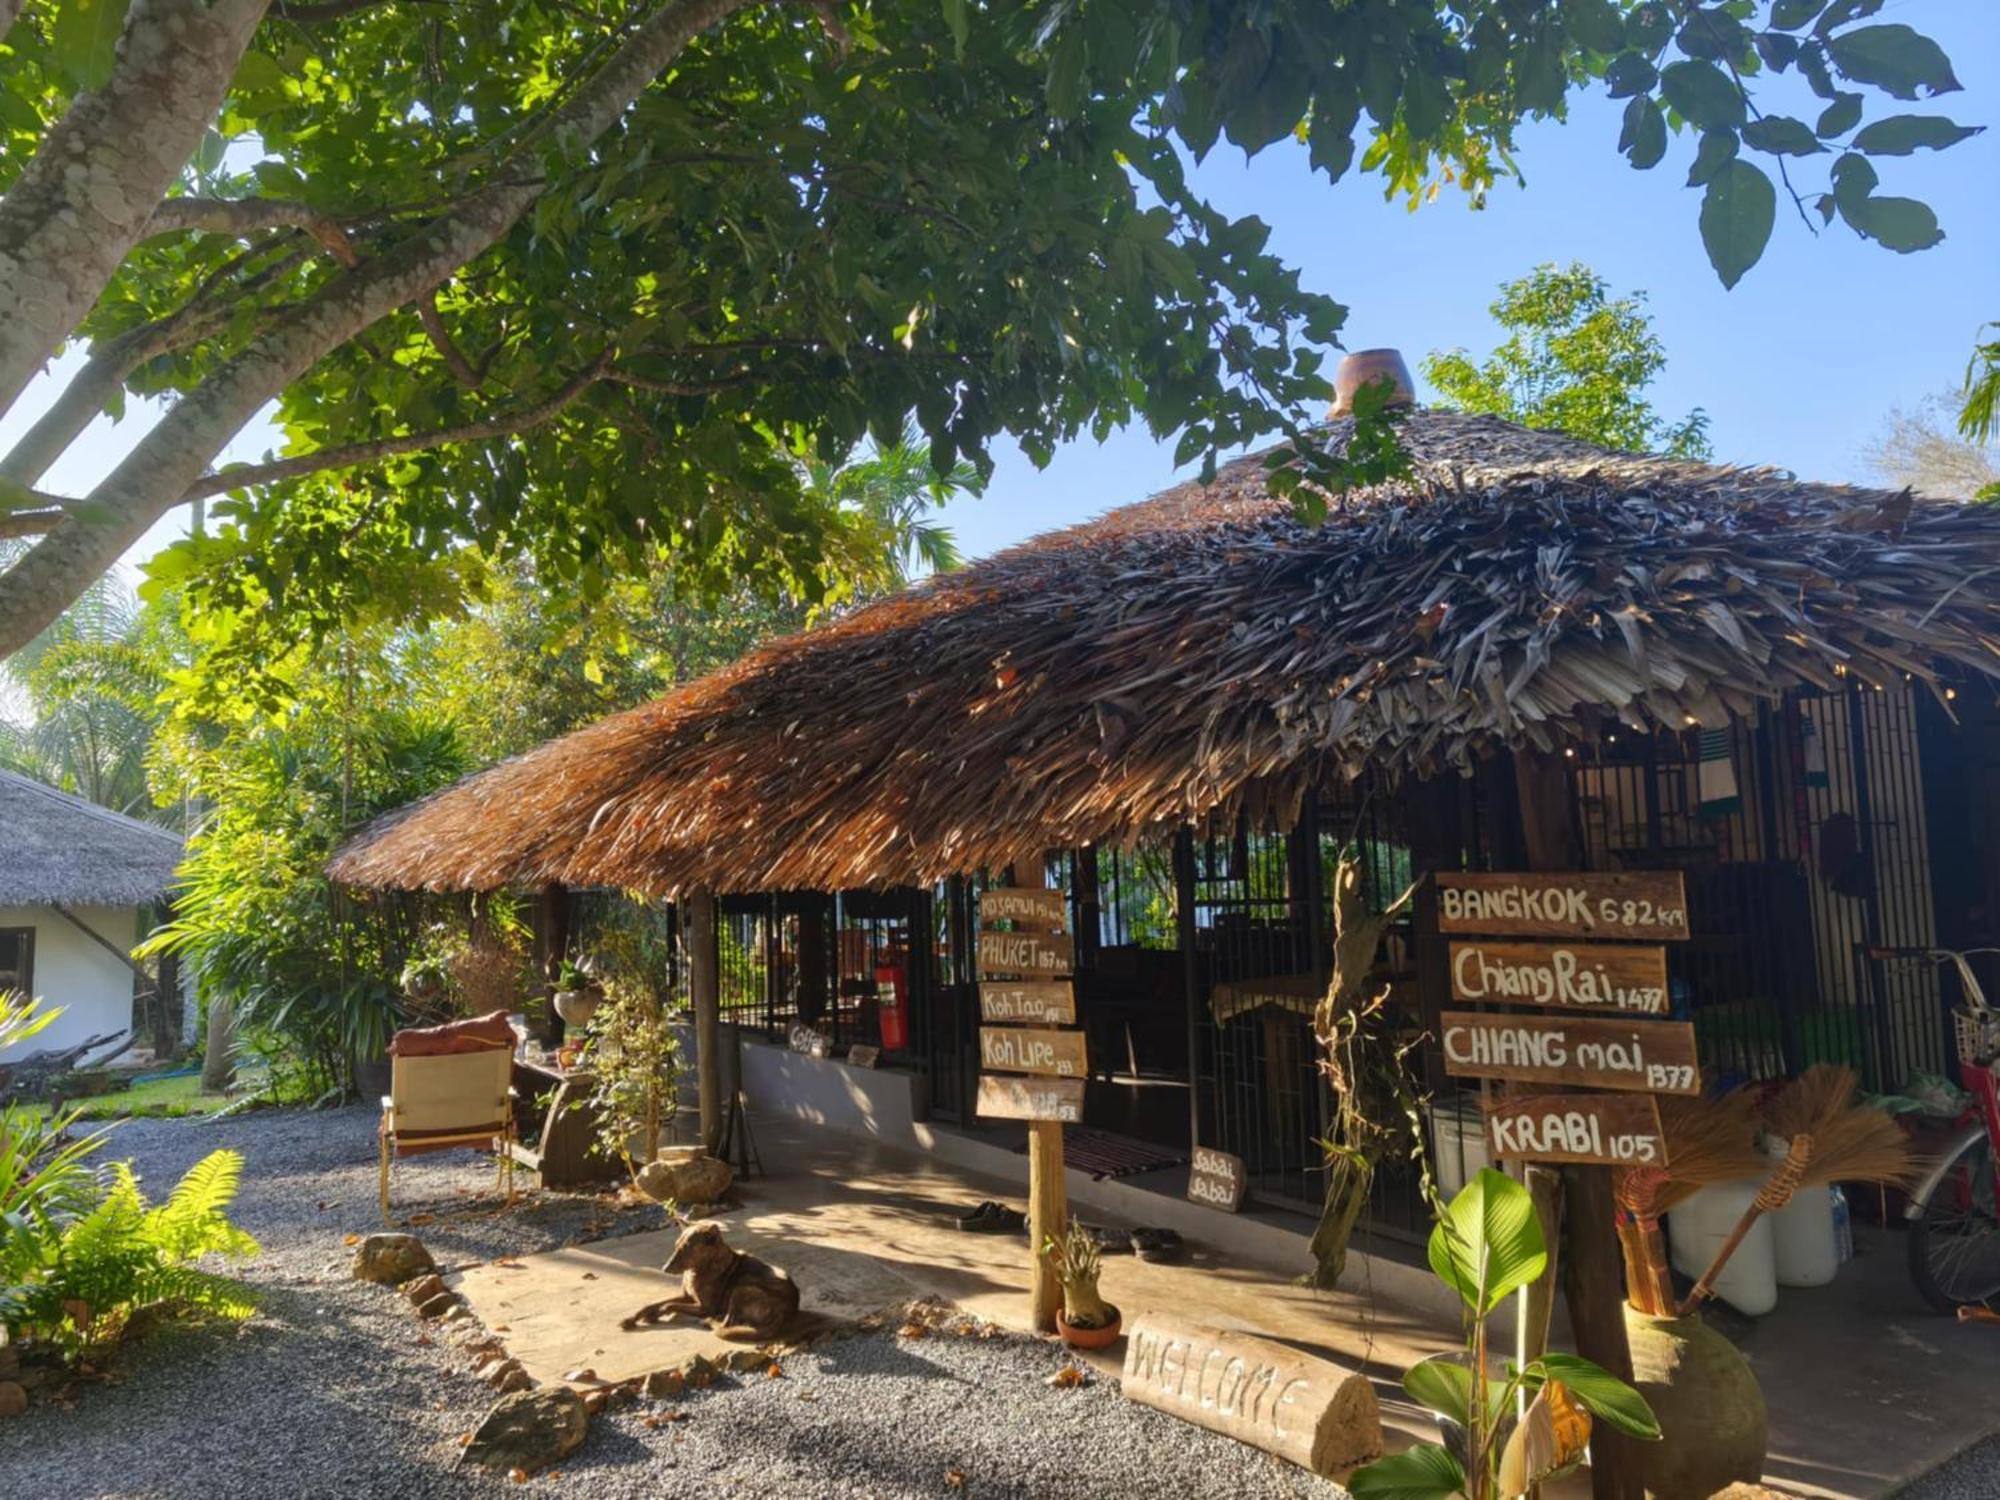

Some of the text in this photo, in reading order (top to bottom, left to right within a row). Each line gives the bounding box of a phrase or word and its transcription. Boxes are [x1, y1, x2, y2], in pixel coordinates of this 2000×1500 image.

[1443, 886, 1595, 928] BANGKOK
[1600, 898, 1656, 927] 682
[981, 936, 1039, 968] PHUKET
[983, 992, 1013, 1018] Koh
[1012, 991, 1044, 1016] Tao
[984, 1032, 1015, 1067] Koh
[1444, 1026, 1568, 1068] CHIANG
[1491, 1112, 1657, 1162] KRABI 105
[1132, 1330, 1310, 1439] WELCOME
